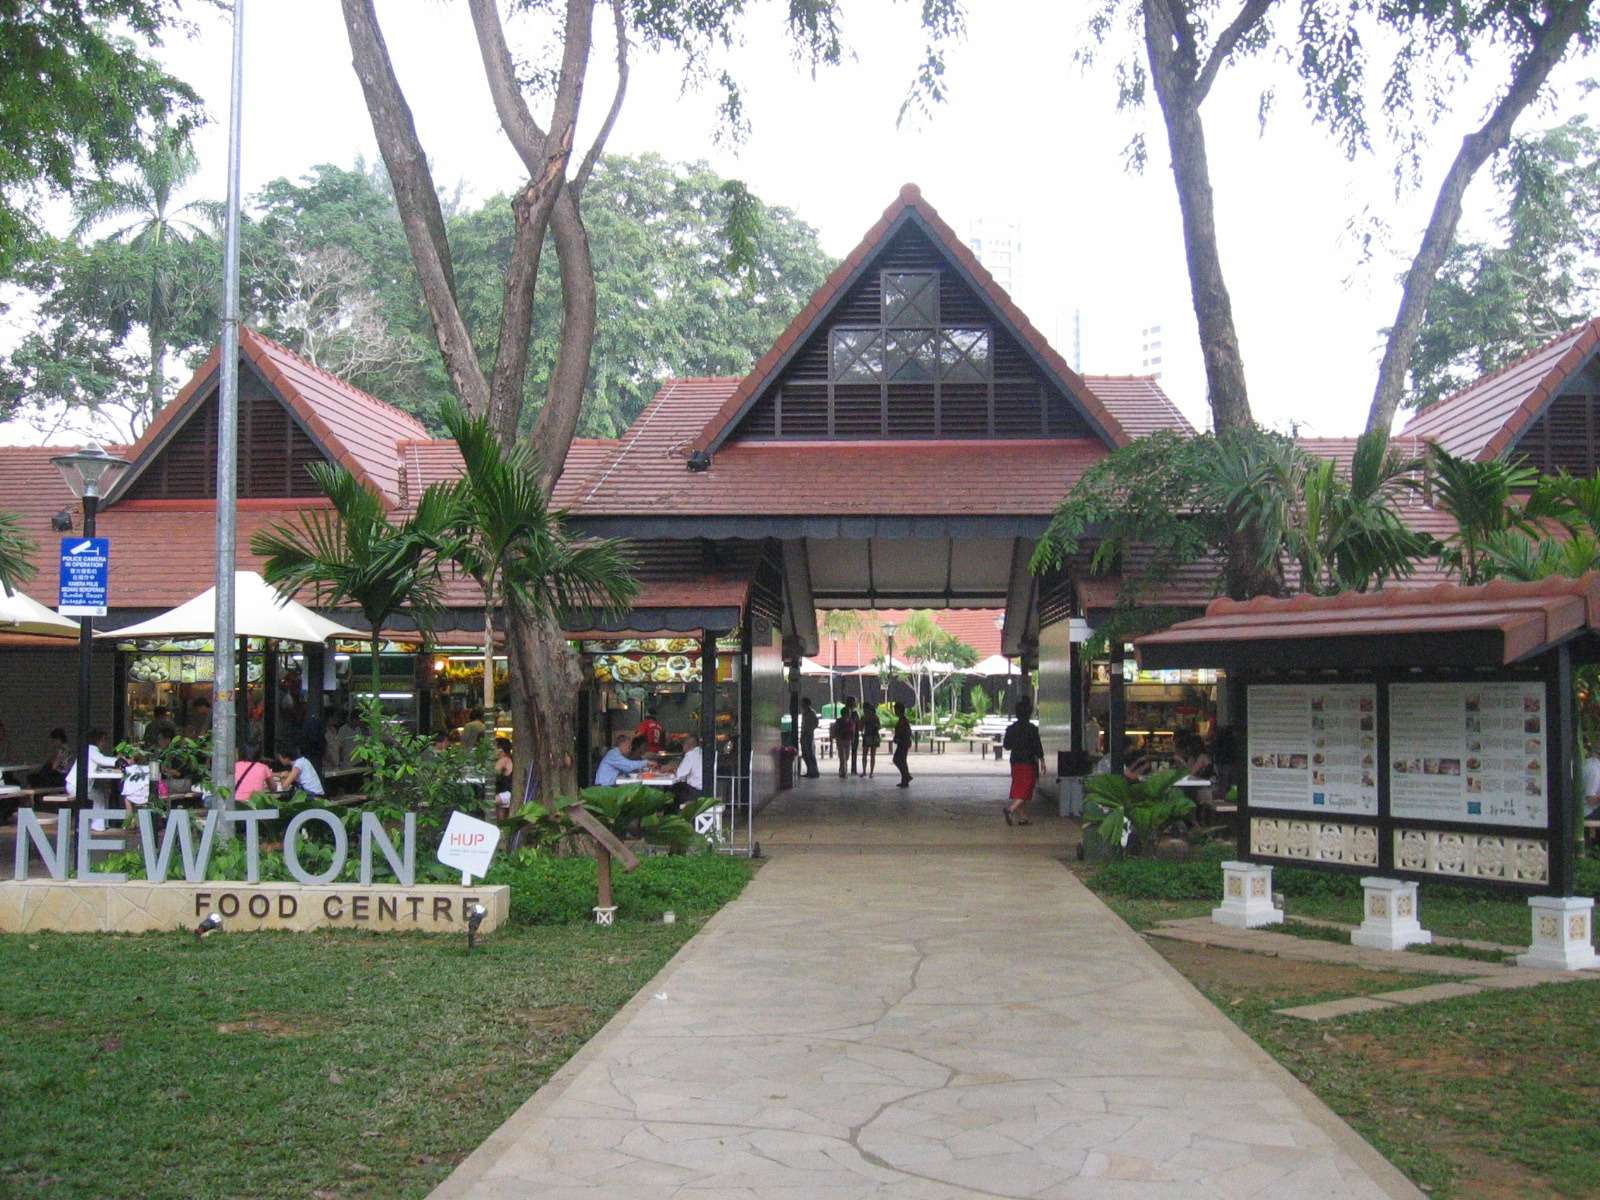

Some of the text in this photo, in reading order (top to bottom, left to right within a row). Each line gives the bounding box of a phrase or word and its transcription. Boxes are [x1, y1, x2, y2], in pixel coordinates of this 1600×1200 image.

[14, 807, 417, 888] NEWTON
[450, 833, 485, 847] HUP
[195, 892, 480, 923] FOOD CENTRE
